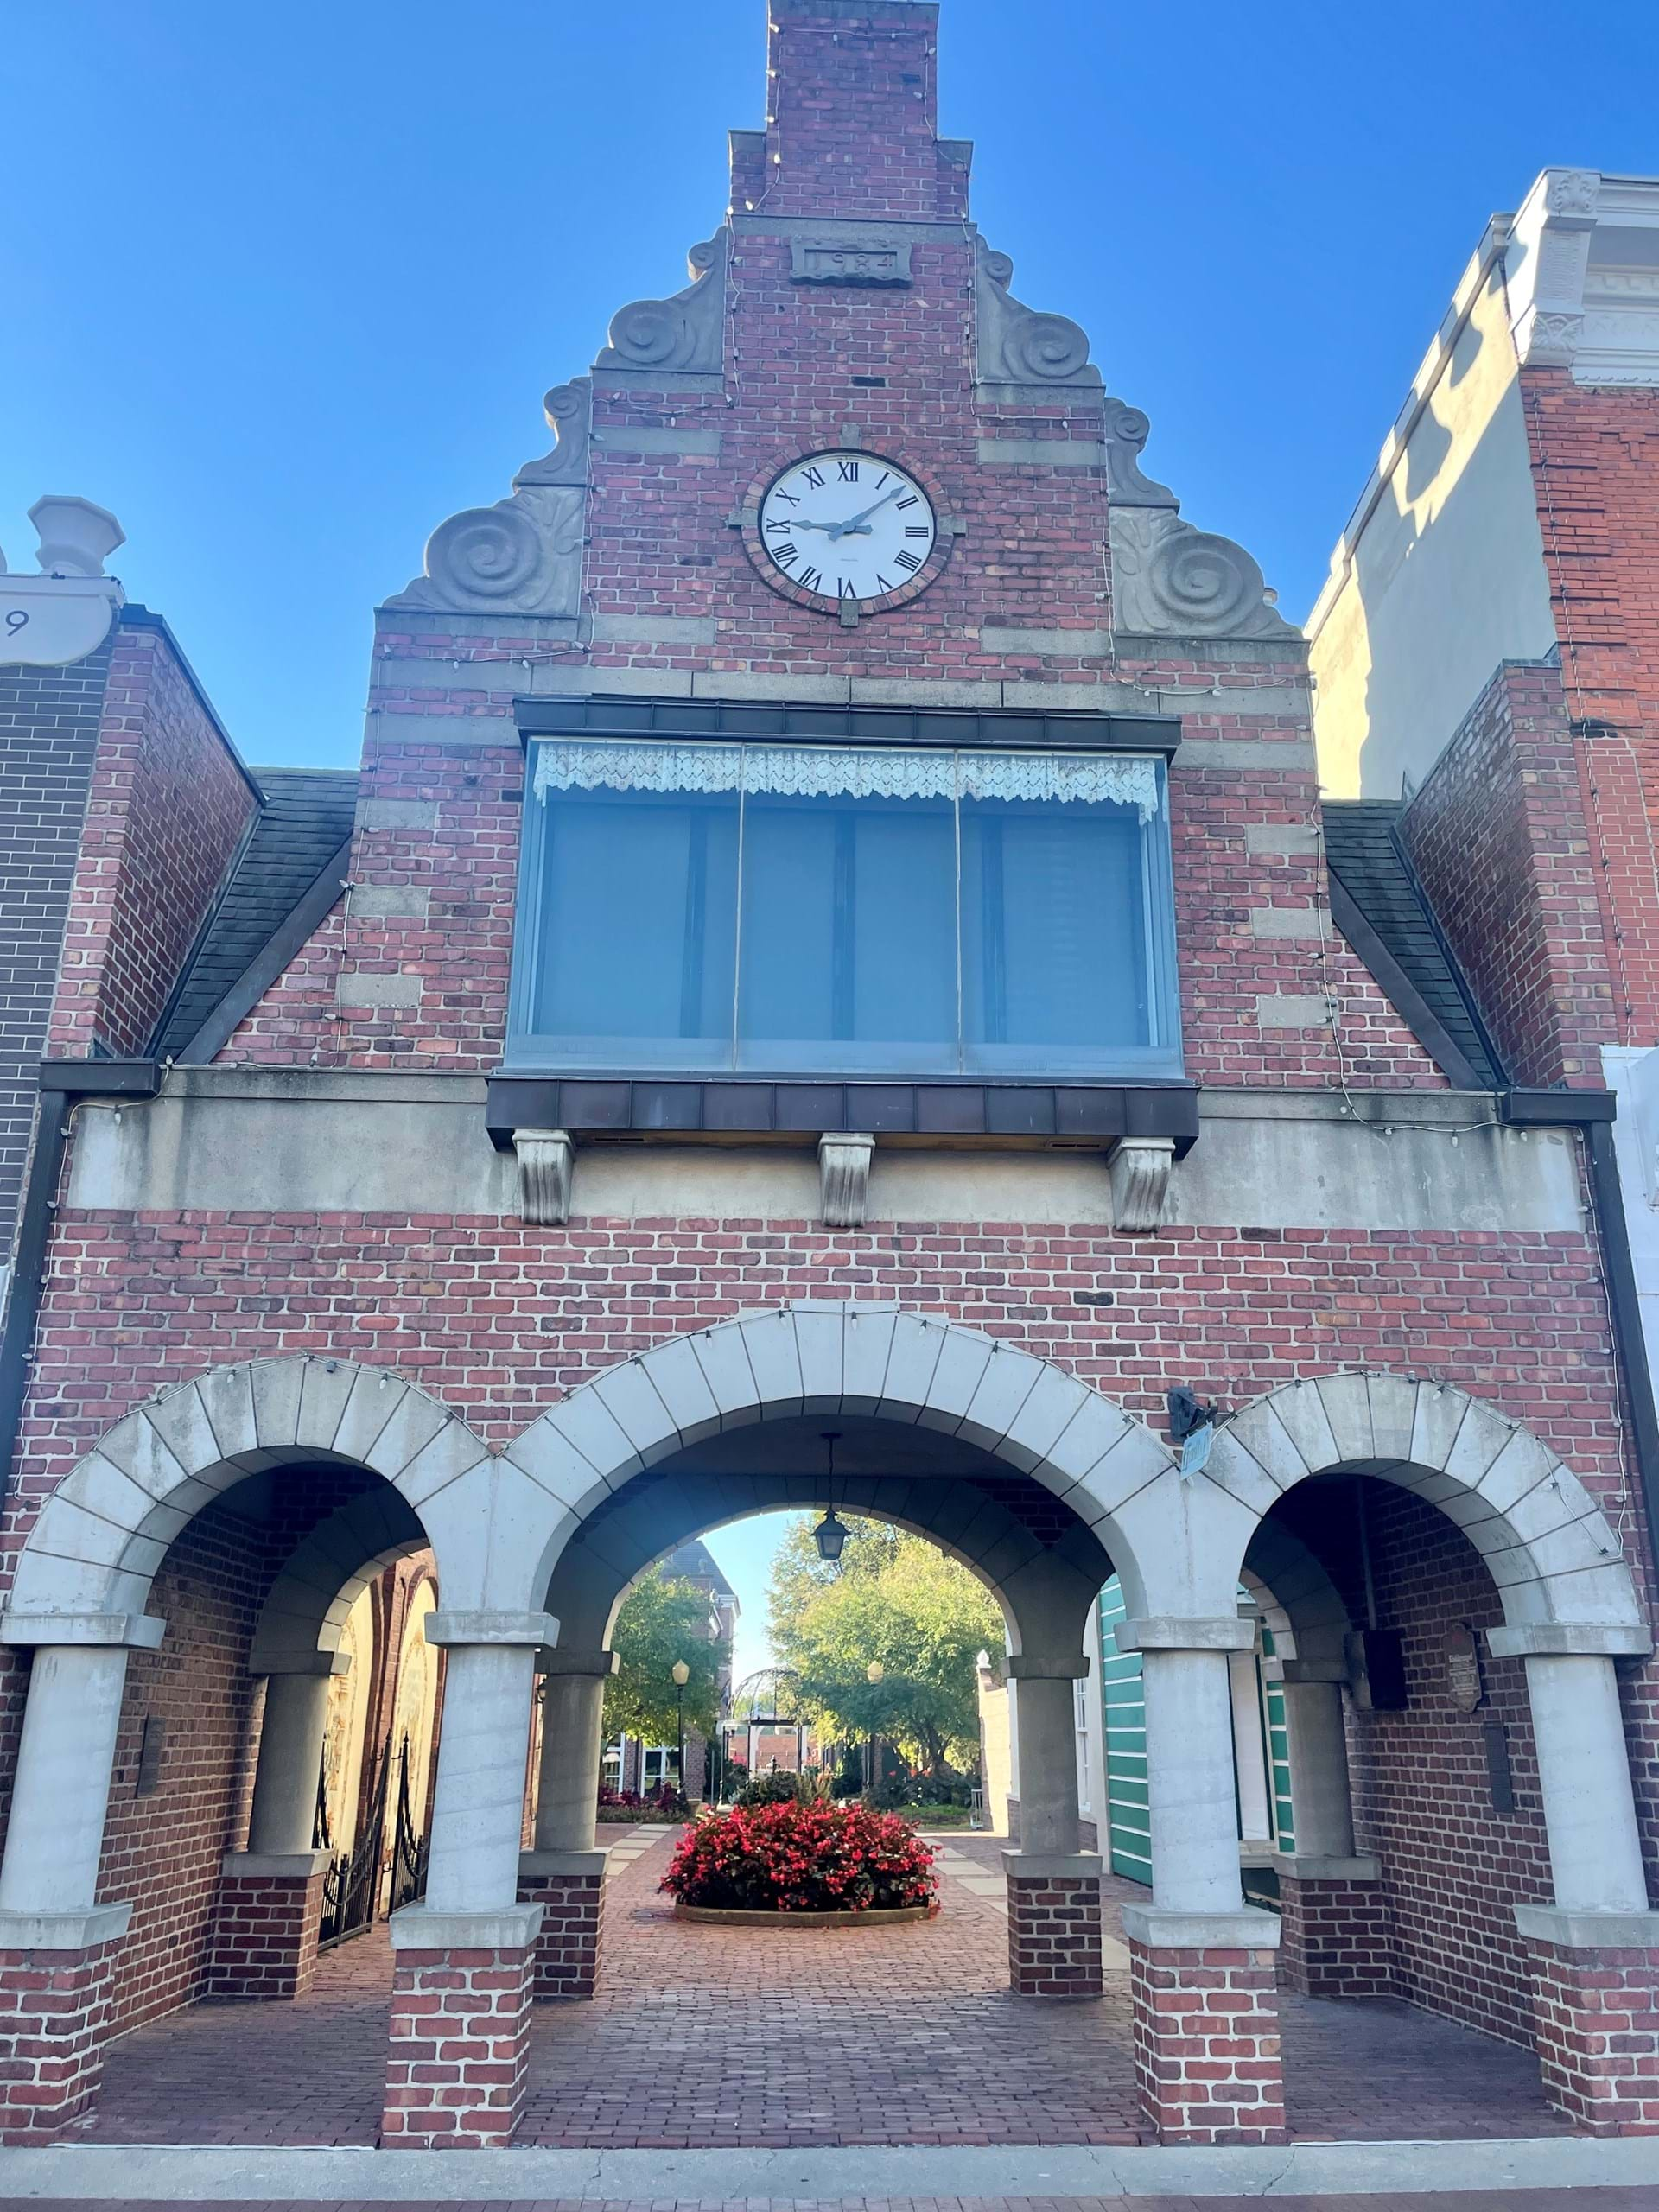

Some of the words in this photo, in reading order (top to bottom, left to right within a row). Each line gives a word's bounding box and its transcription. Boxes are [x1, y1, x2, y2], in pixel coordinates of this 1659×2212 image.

[807, 252, 893, 272] 1984
[801, 467, 826, 490] XI
[837, 461, 859, 482] XII
[874, 472, 890, 490] I
[775, 487, 802, 507] X
[895, 495, 919, 510] II
[766, 518, 791, 534] IX
[905, 526, 929, 537] III
[771, 543, 800, 570] VIII
[893, 550, 923, 573] IIII
[798, 566, 823, 592] VII
[837, 577, 857, 598] VI
[876, 574, 894, 594] V
[5, 610, 29, 637] 9
